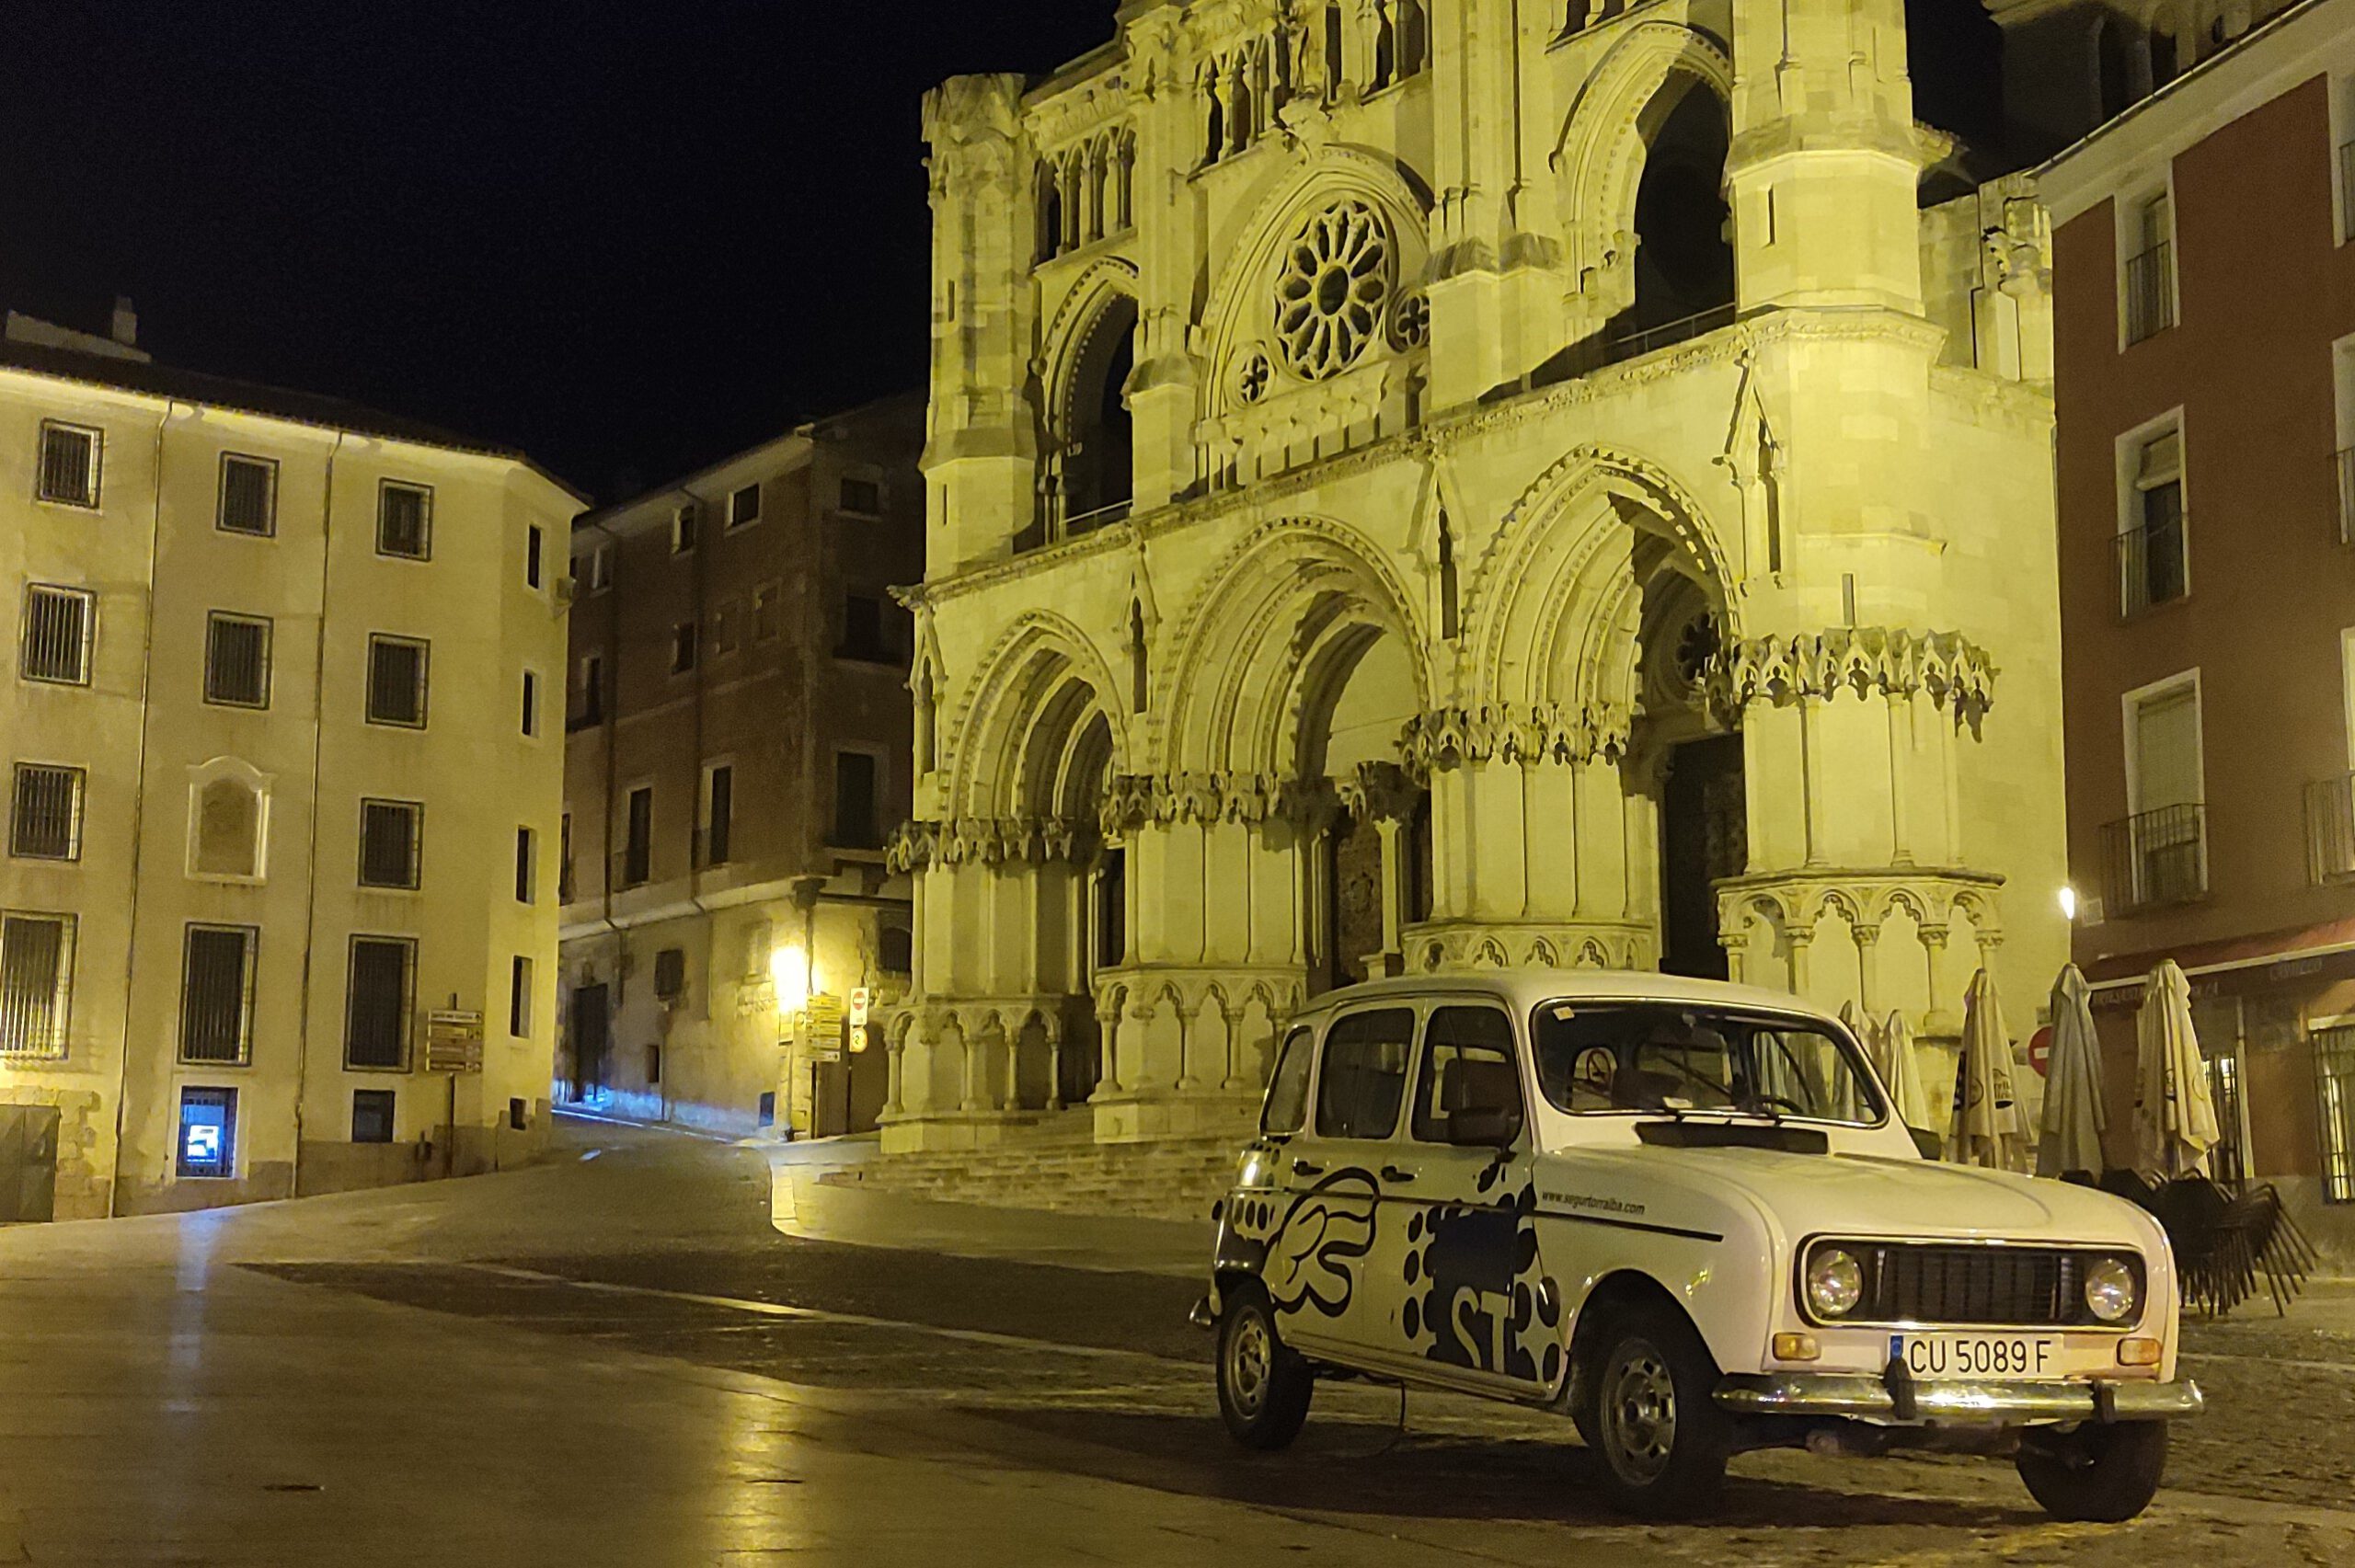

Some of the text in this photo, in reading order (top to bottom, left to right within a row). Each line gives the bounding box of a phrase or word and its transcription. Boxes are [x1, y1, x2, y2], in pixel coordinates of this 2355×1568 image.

[1911, 1340, 2051, 1373] CU 5089 F
